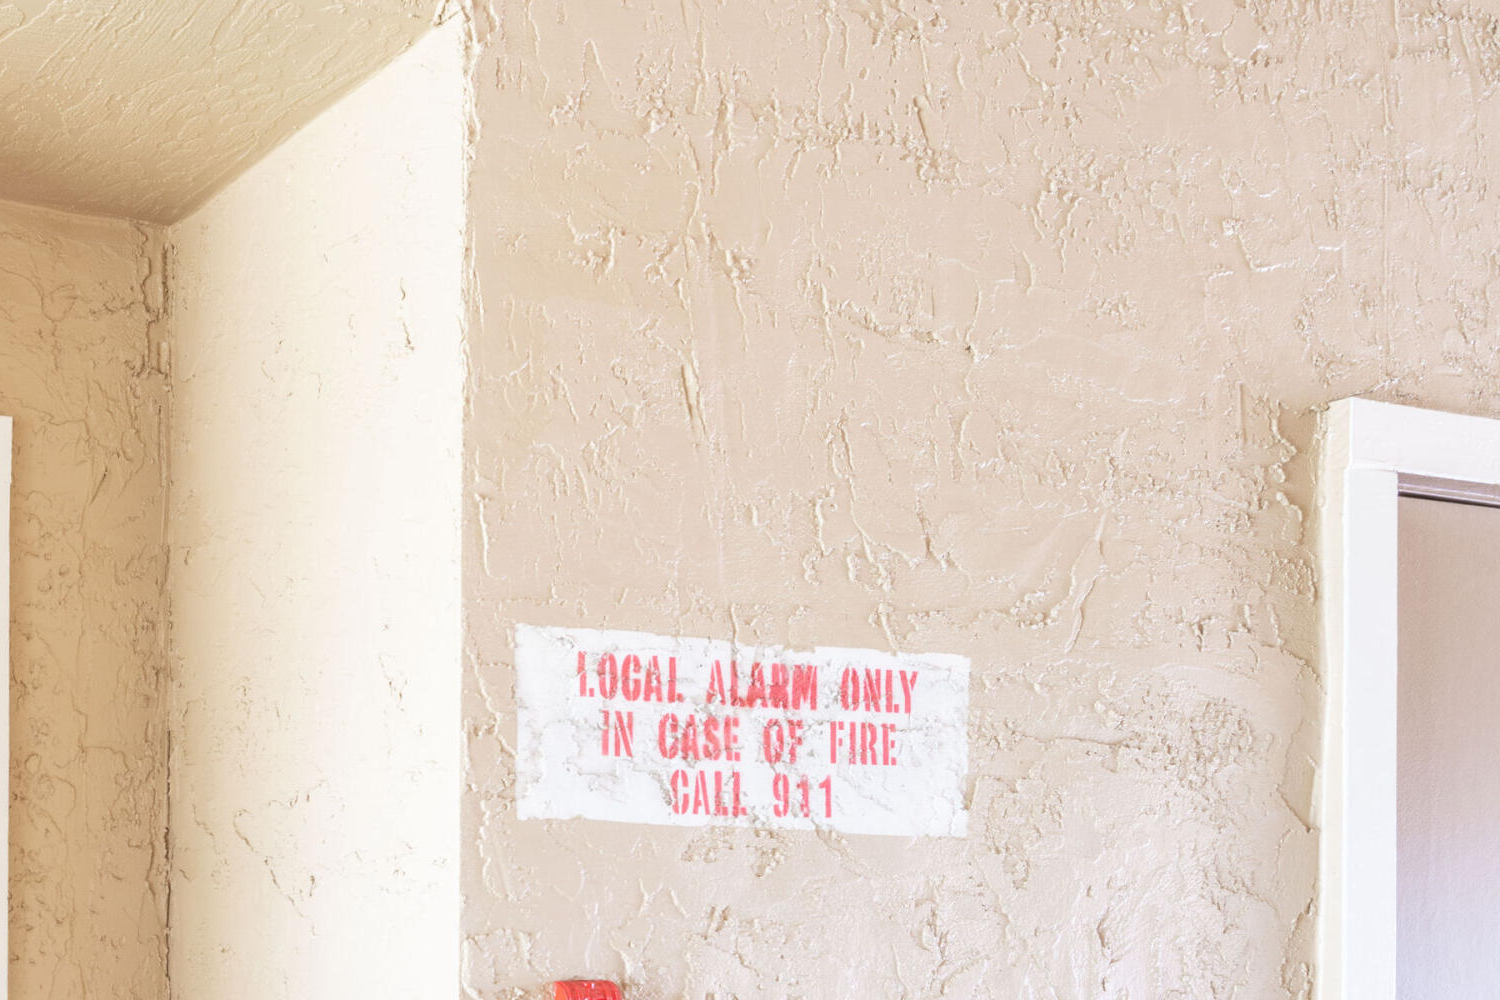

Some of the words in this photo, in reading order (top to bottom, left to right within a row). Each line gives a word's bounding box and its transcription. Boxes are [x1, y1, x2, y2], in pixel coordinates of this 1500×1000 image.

[577, 651, 683, 702] LOCAL
[706, 660, 818, 711] ALARM
[840, 667, 919, 714] ONLY
[601, 710, 634, 757] IN
[658, 713, 741, 762] CASE
[763, 718, 804, 763] OF
[829, 721, 897, 766] FIRE
[669, 769, 747, 816] CALL
[772, 773, 832, 818] 911
